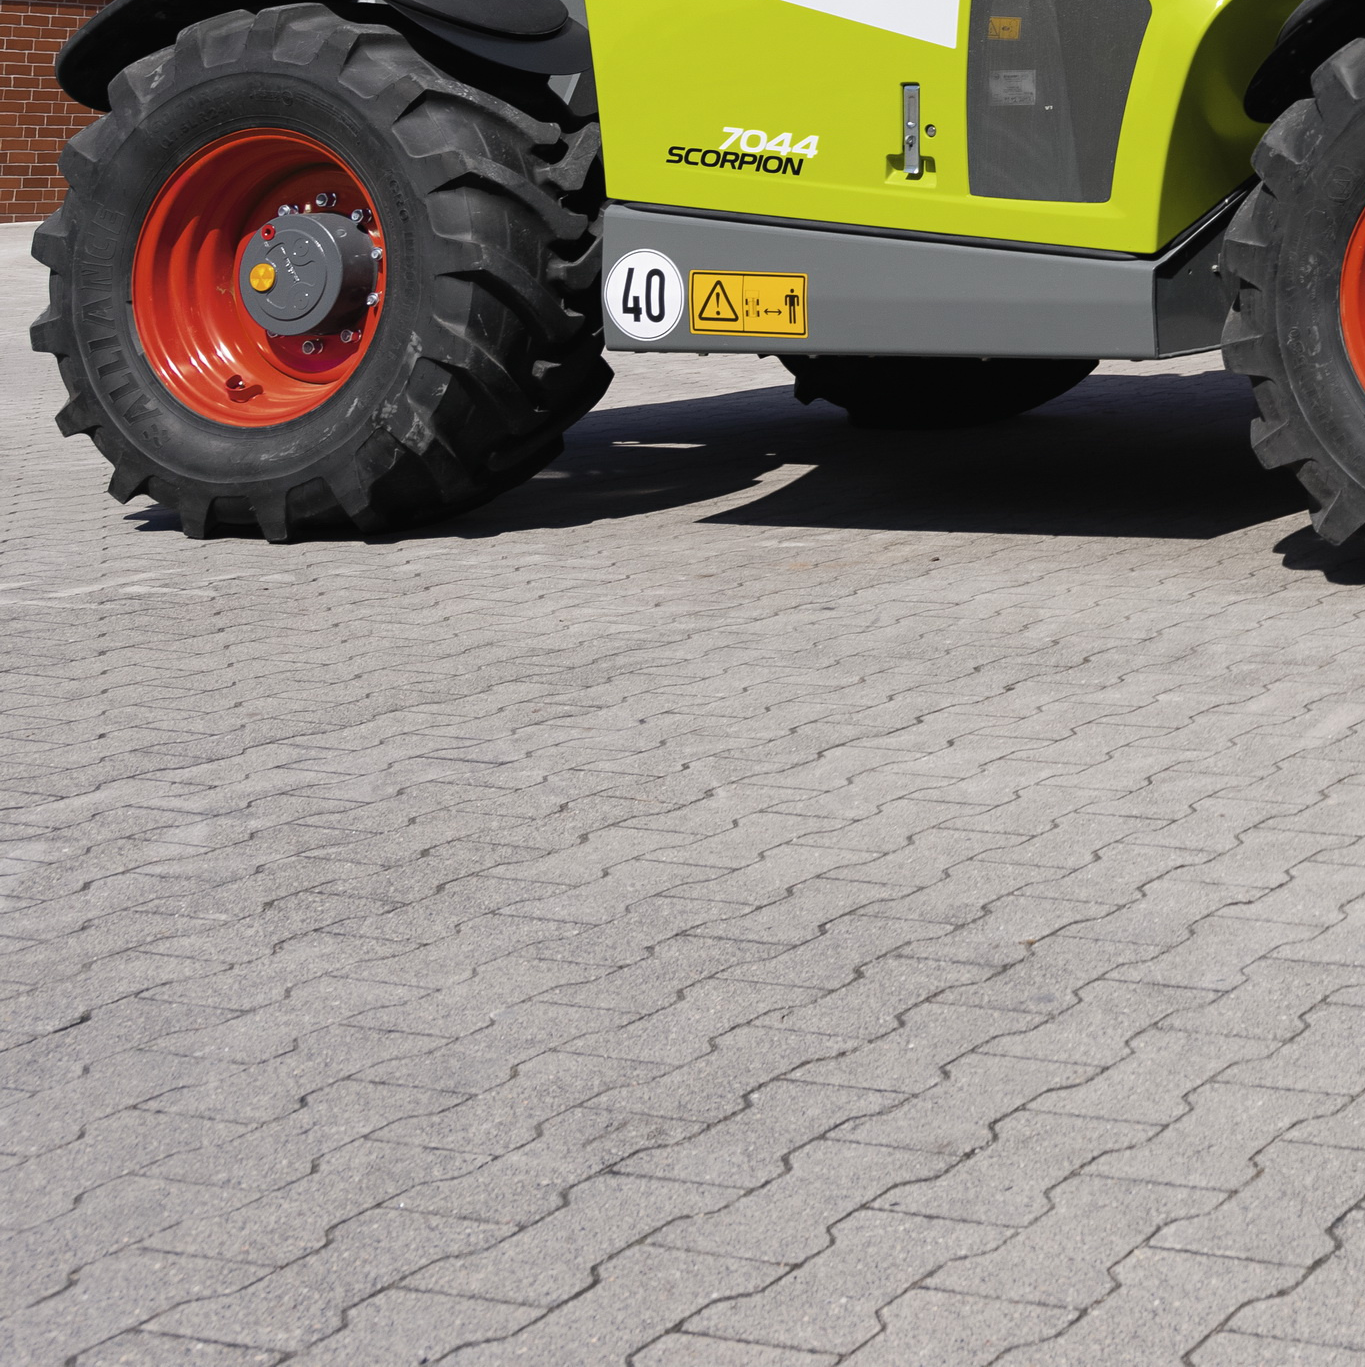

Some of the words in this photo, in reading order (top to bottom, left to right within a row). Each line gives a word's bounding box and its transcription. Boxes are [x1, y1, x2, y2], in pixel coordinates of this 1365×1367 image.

[665, 146, 804, 176] SCORPION
[718, 126, 819, 158] 7044
[622, 267, 665, 323] 40
[81, 206, 162, 433] ALLIANCE
